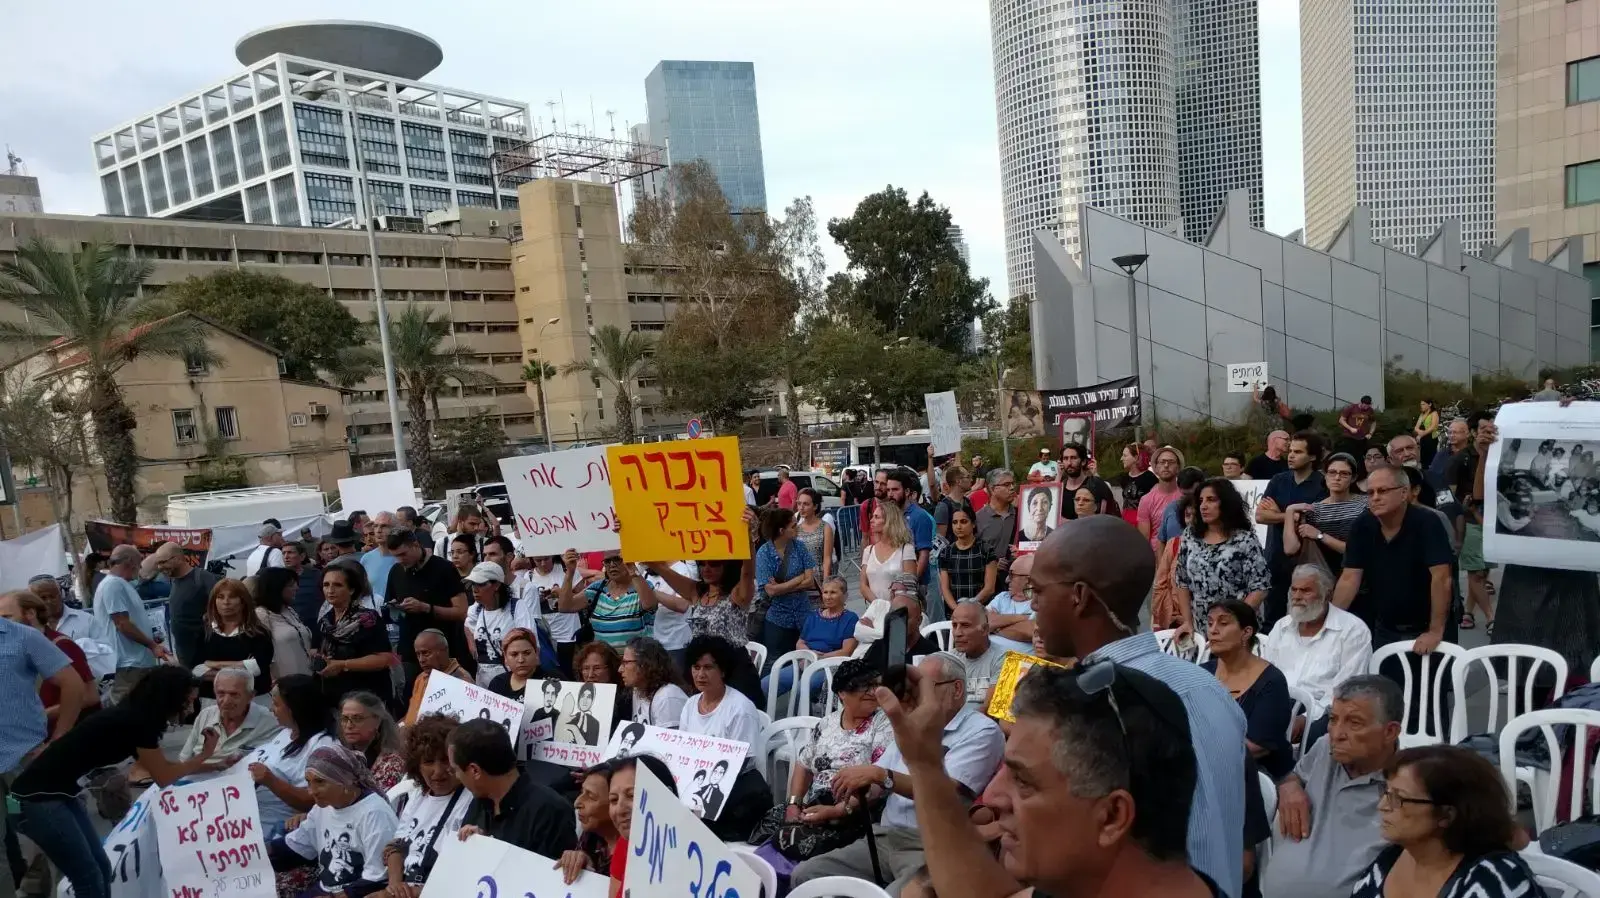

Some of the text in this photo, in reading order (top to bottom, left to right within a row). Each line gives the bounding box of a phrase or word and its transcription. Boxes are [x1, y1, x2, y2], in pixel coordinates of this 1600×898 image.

[1067, 393, 1081, 406] היה
[522, 462, 564, 489] אחי
[619, 449, 728, 492] הכרה
[653, 500, 727, 532] צדק
[571, 747, 601, 763] איפה
[159, 790, 180, 816] שלי
[187, 791, 210, 821] יקר
[222, 786, 240, 816] בן
[177, 814, 253, 845] מעולם לא
